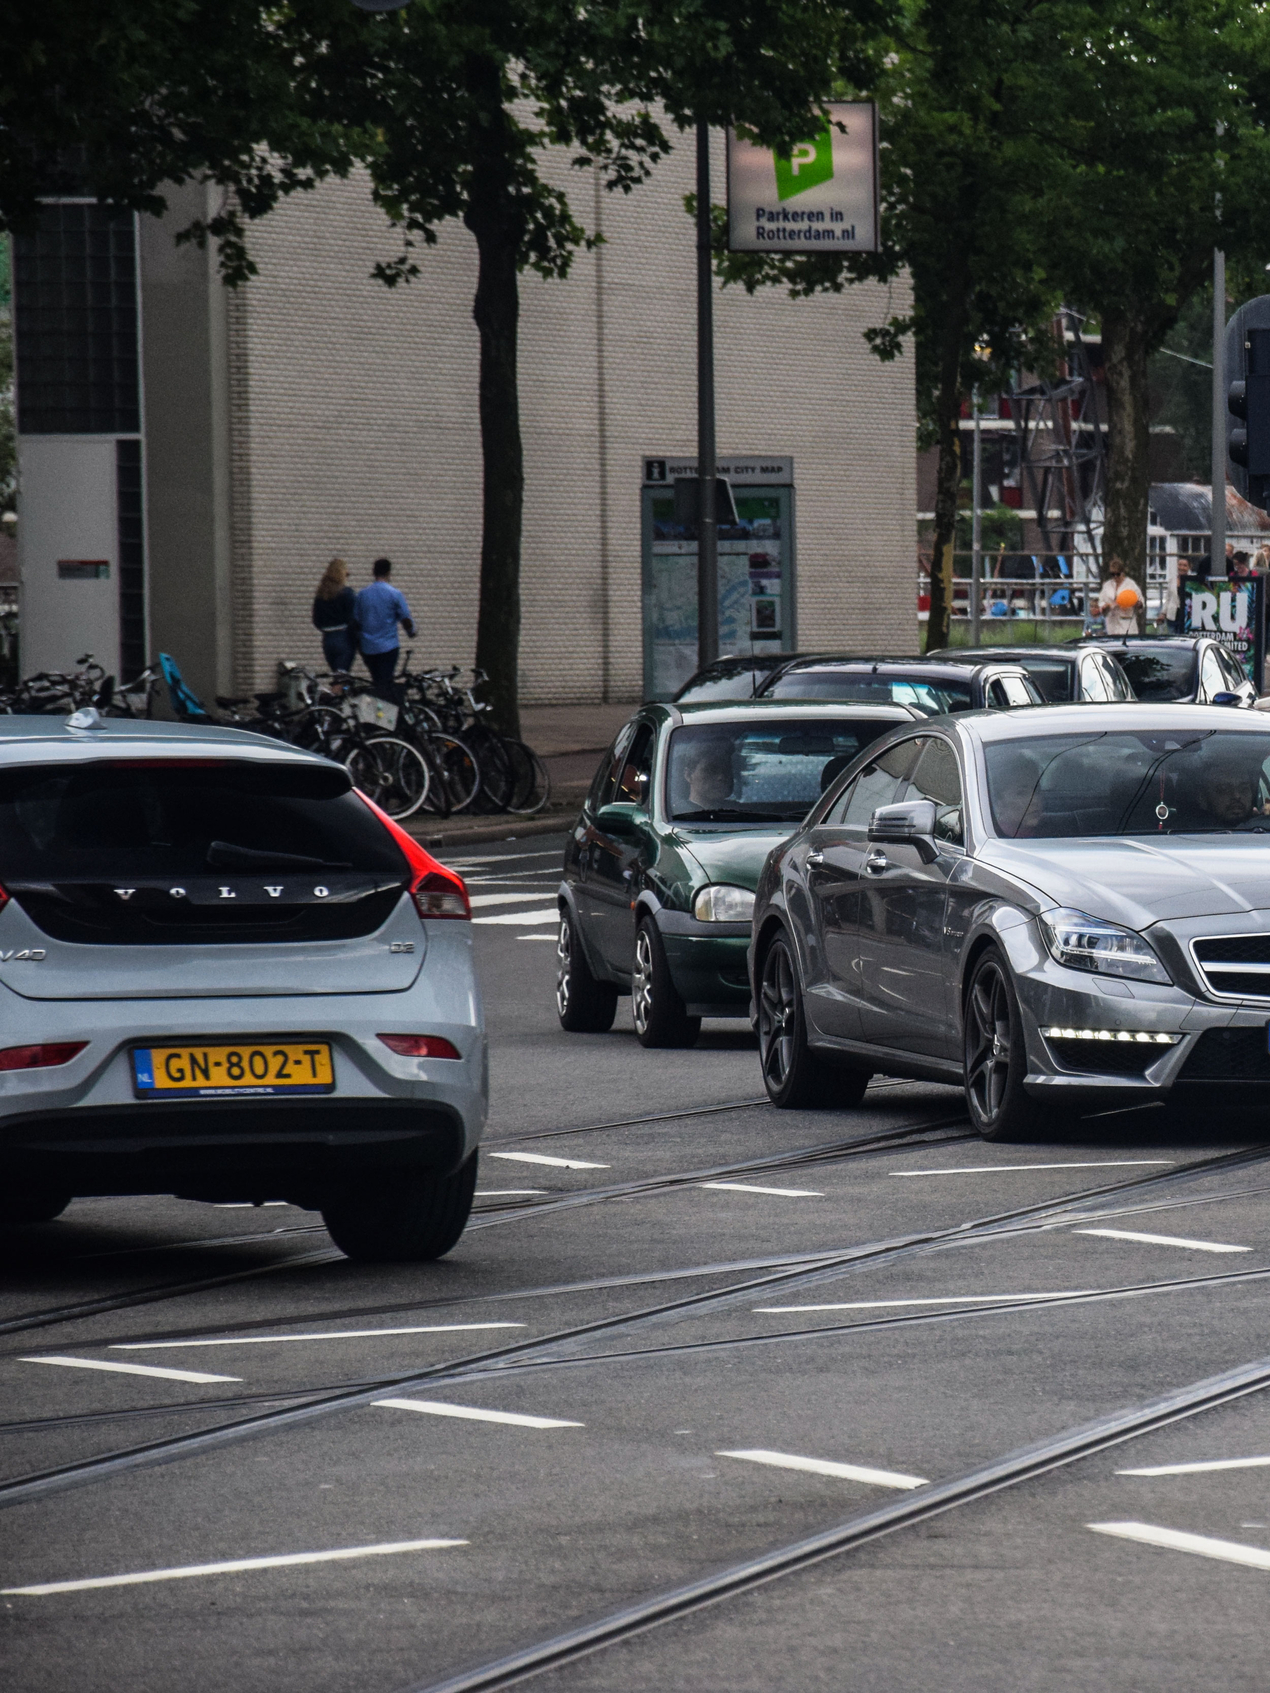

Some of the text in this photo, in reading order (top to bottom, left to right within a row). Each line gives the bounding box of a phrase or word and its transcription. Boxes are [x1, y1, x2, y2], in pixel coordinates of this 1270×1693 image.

[791, 143, 817, 176] P
[756, 207, 844, 223] Parkeren in
[756, 225, 856, 241] Rotterdam.nl
[669, 466, 784, 475] ROTTEAM CITY MAP
[1191, 590, 1249, 634] RU
[113, 885, 329, 901] VOLVO
[0, 949, 46, 962] V40
[137, 1049, 321, 1083] NL GN-802-T
